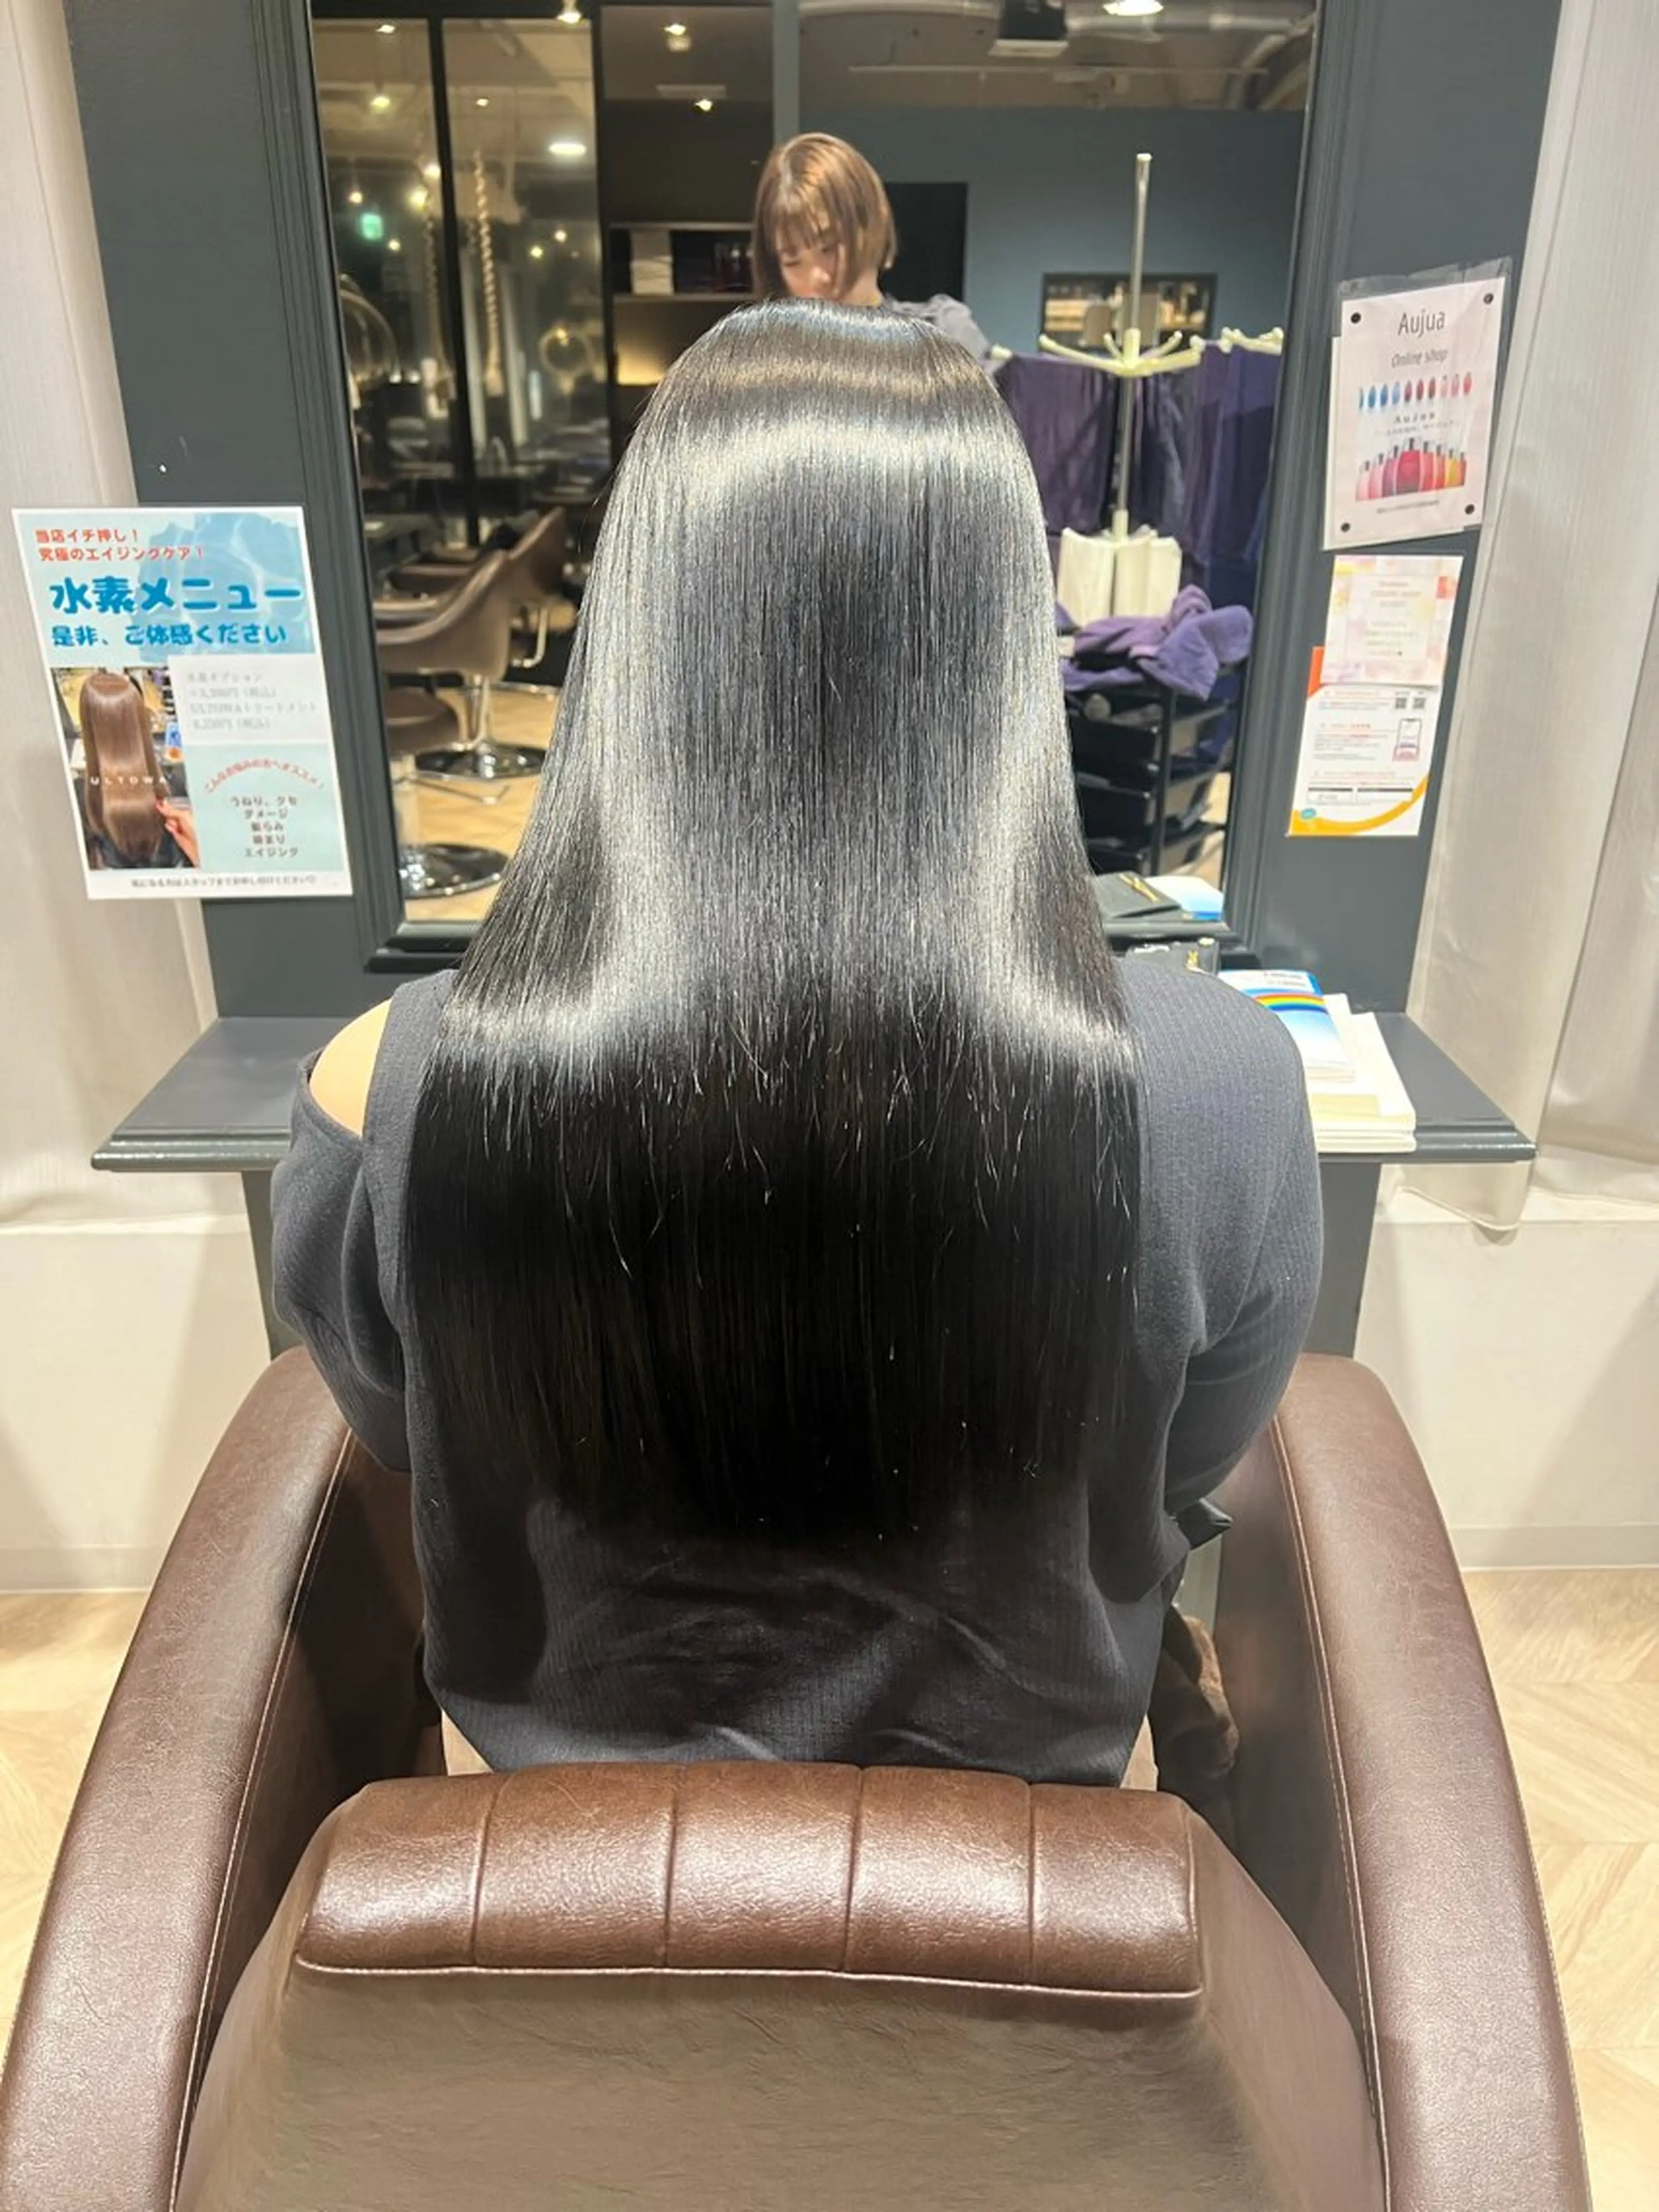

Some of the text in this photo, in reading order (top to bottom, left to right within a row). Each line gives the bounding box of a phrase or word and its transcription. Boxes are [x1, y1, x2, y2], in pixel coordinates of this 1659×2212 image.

[1398, 308, 1446, 339] Aujua
[49, 575, 301, 614] 水素メニュー
[51, 623, 286, 646] 是非、ご体感ください
